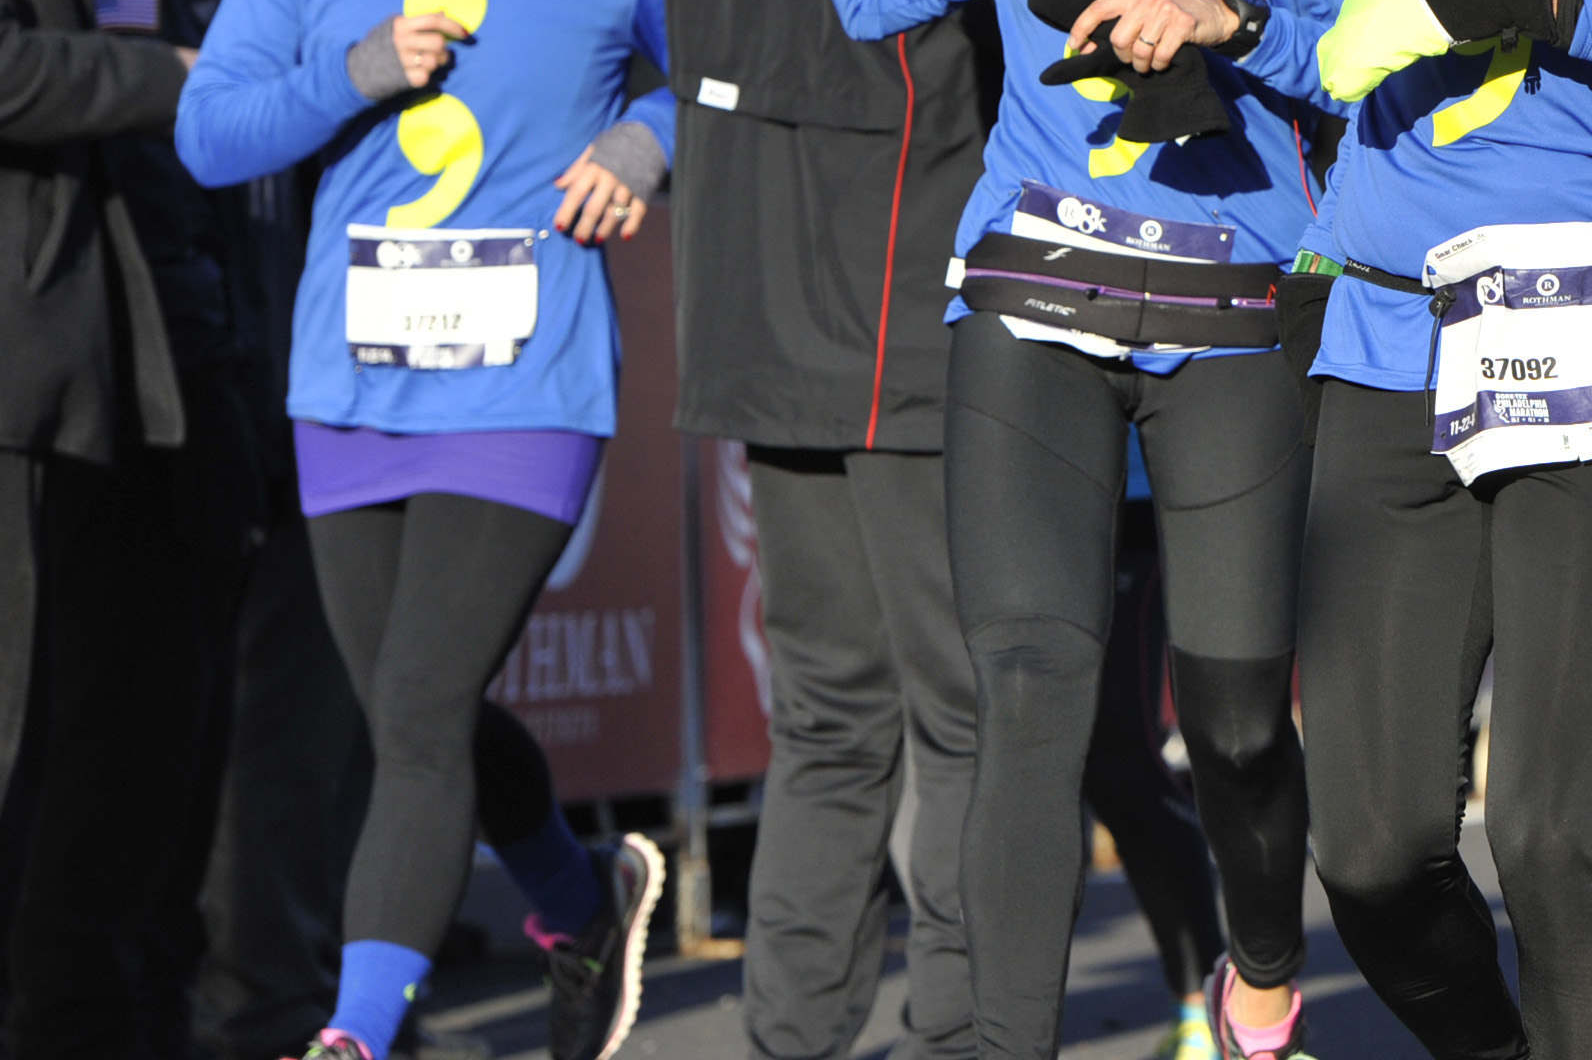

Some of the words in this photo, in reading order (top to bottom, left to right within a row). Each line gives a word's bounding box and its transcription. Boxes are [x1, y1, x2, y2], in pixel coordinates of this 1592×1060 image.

[1522, 294, 1572, 305] ROTHMAN
[1480, 356, 1559, 381] 37092
[1496, 399, 1548, 409] PHILADELPHIA
[1509, 408, 1549, 418] MARATHON
